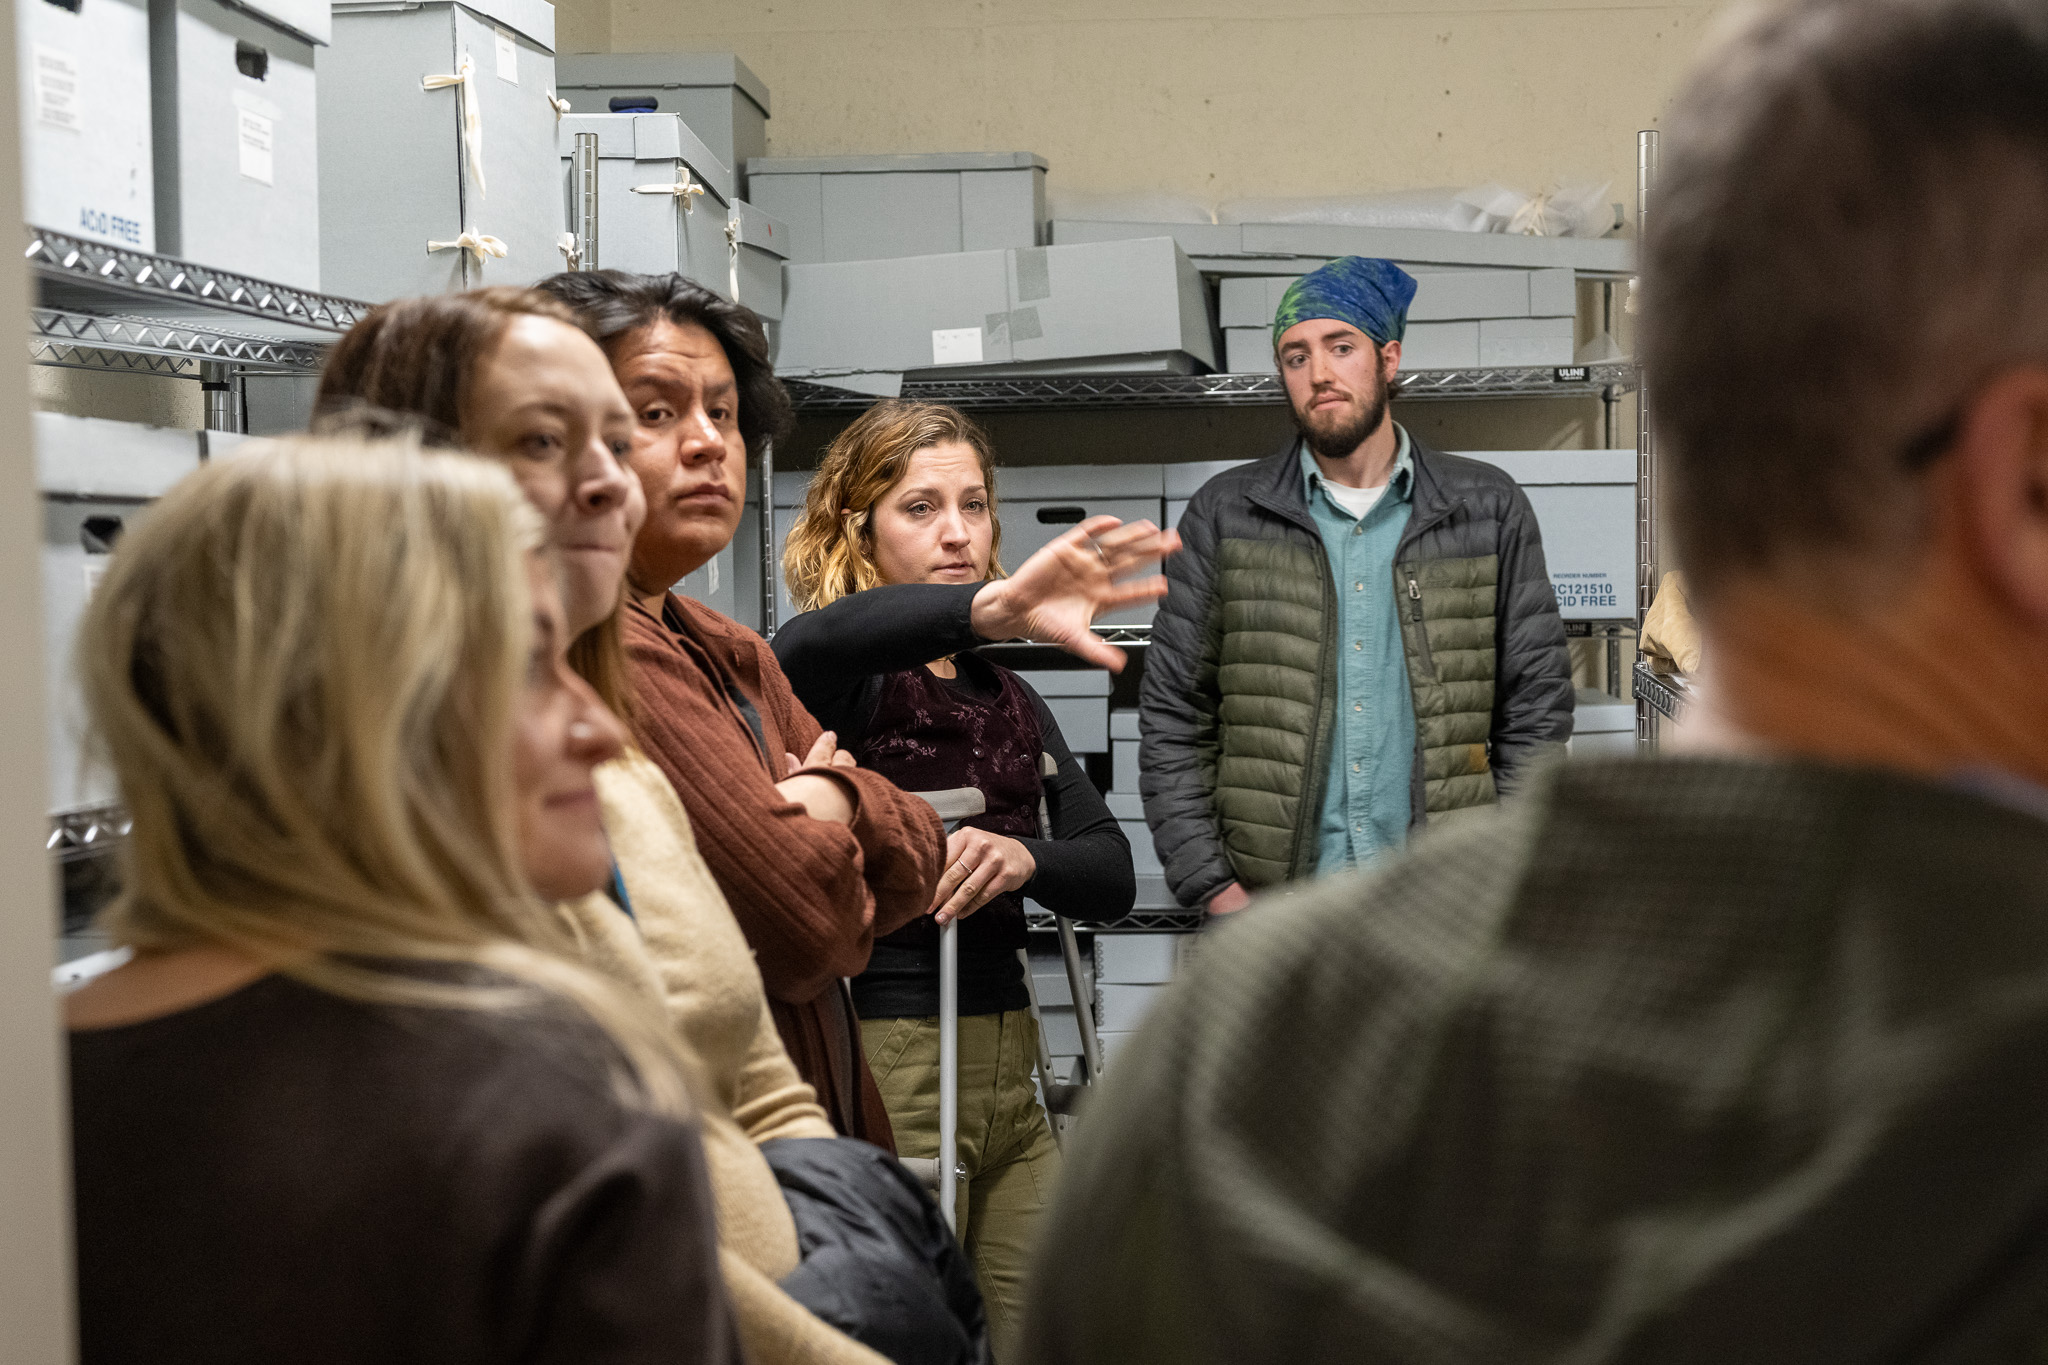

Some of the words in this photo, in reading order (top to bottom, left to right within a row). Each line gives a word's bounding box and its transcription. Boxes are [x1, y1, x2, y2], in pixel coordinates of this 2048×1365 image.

[111, 216, 140, 243] FREE
[1559, 367, 1585, 376] ULINE
[1556, 596, 1577, 606] CID
[1581, 595, 1616, 606] FREE
